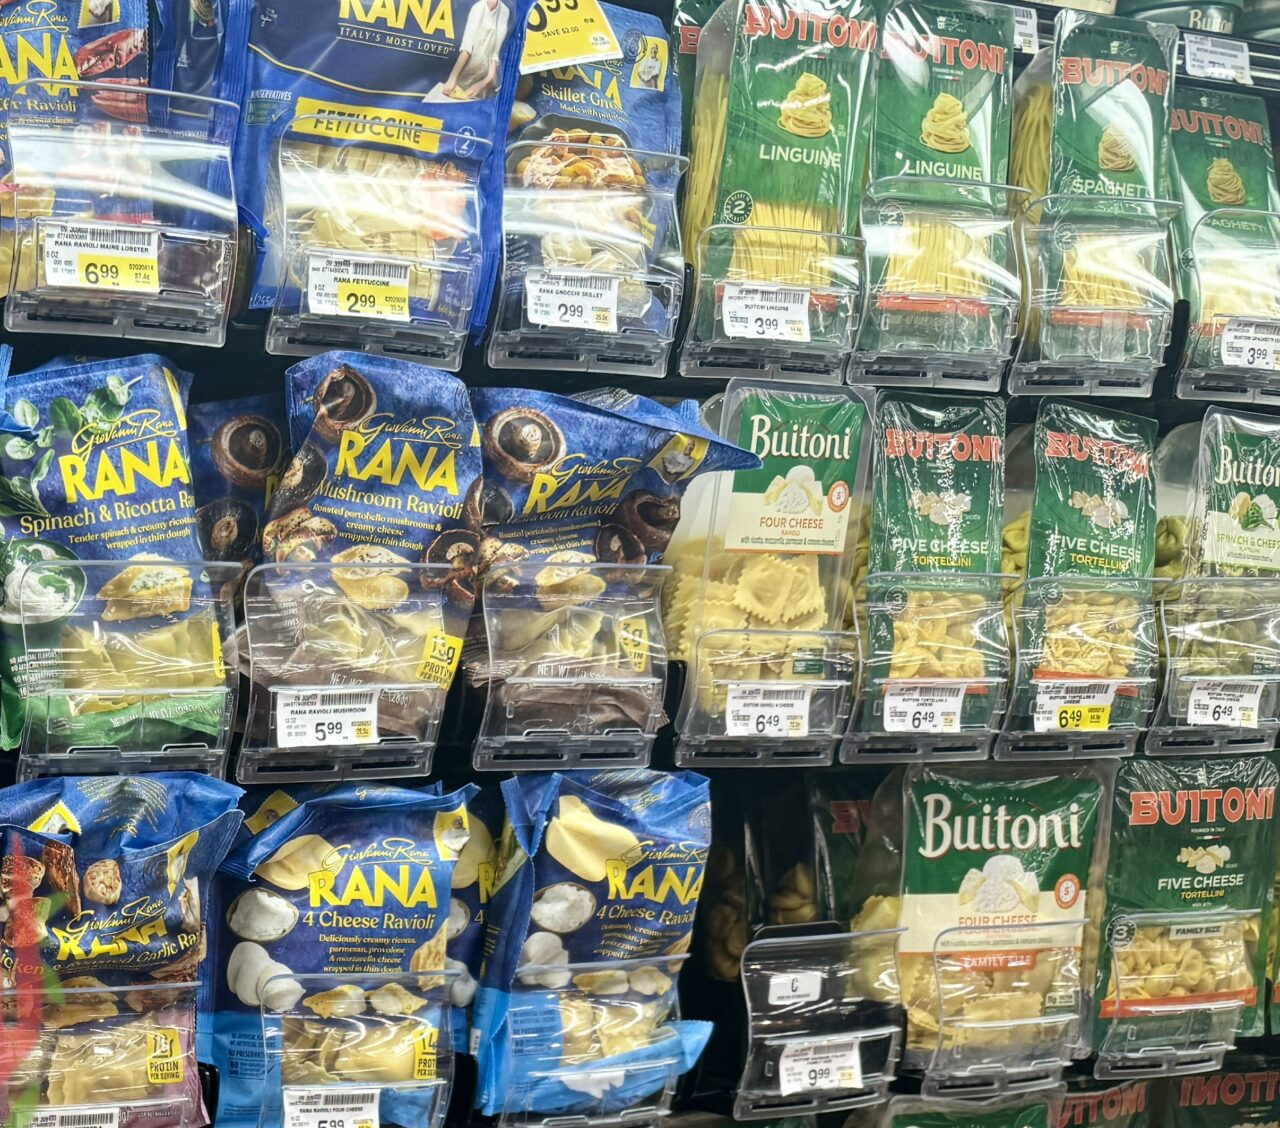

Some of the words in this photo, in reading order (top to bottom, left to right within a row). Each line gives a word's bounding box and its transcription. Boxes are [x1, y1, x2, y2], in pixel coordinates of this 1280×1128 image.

[338, 0, 455, 39] RANA
[314, 108, 422, 144] FETTUCCINE
[750, 413, 851, 462] Buitoni
[59, 442, 192, 503] RANA
[335, 430, 458, 495] RANA
[21, 514, 95, 535] Spinach
[100, 506, 111, 522] &
[115, 499, 175, 520] Ricotta
[316, 479, 402, 508] Mushroom
[407, 497, 463, 519] Ravioli
[1130, 787, 1273, 825] BUITONI
[919, 792, 1082, 860] Buitoni
[309, 864, 437, 907] RANA
[1158, 876, 1190, 891] FIVE
[1194, 873, 1244, 888] CHEESE
[303, 912, 313, 926] 4
[320, 912, 378, 929] Cheese
[383, 913, 434, 929] Ravioli
